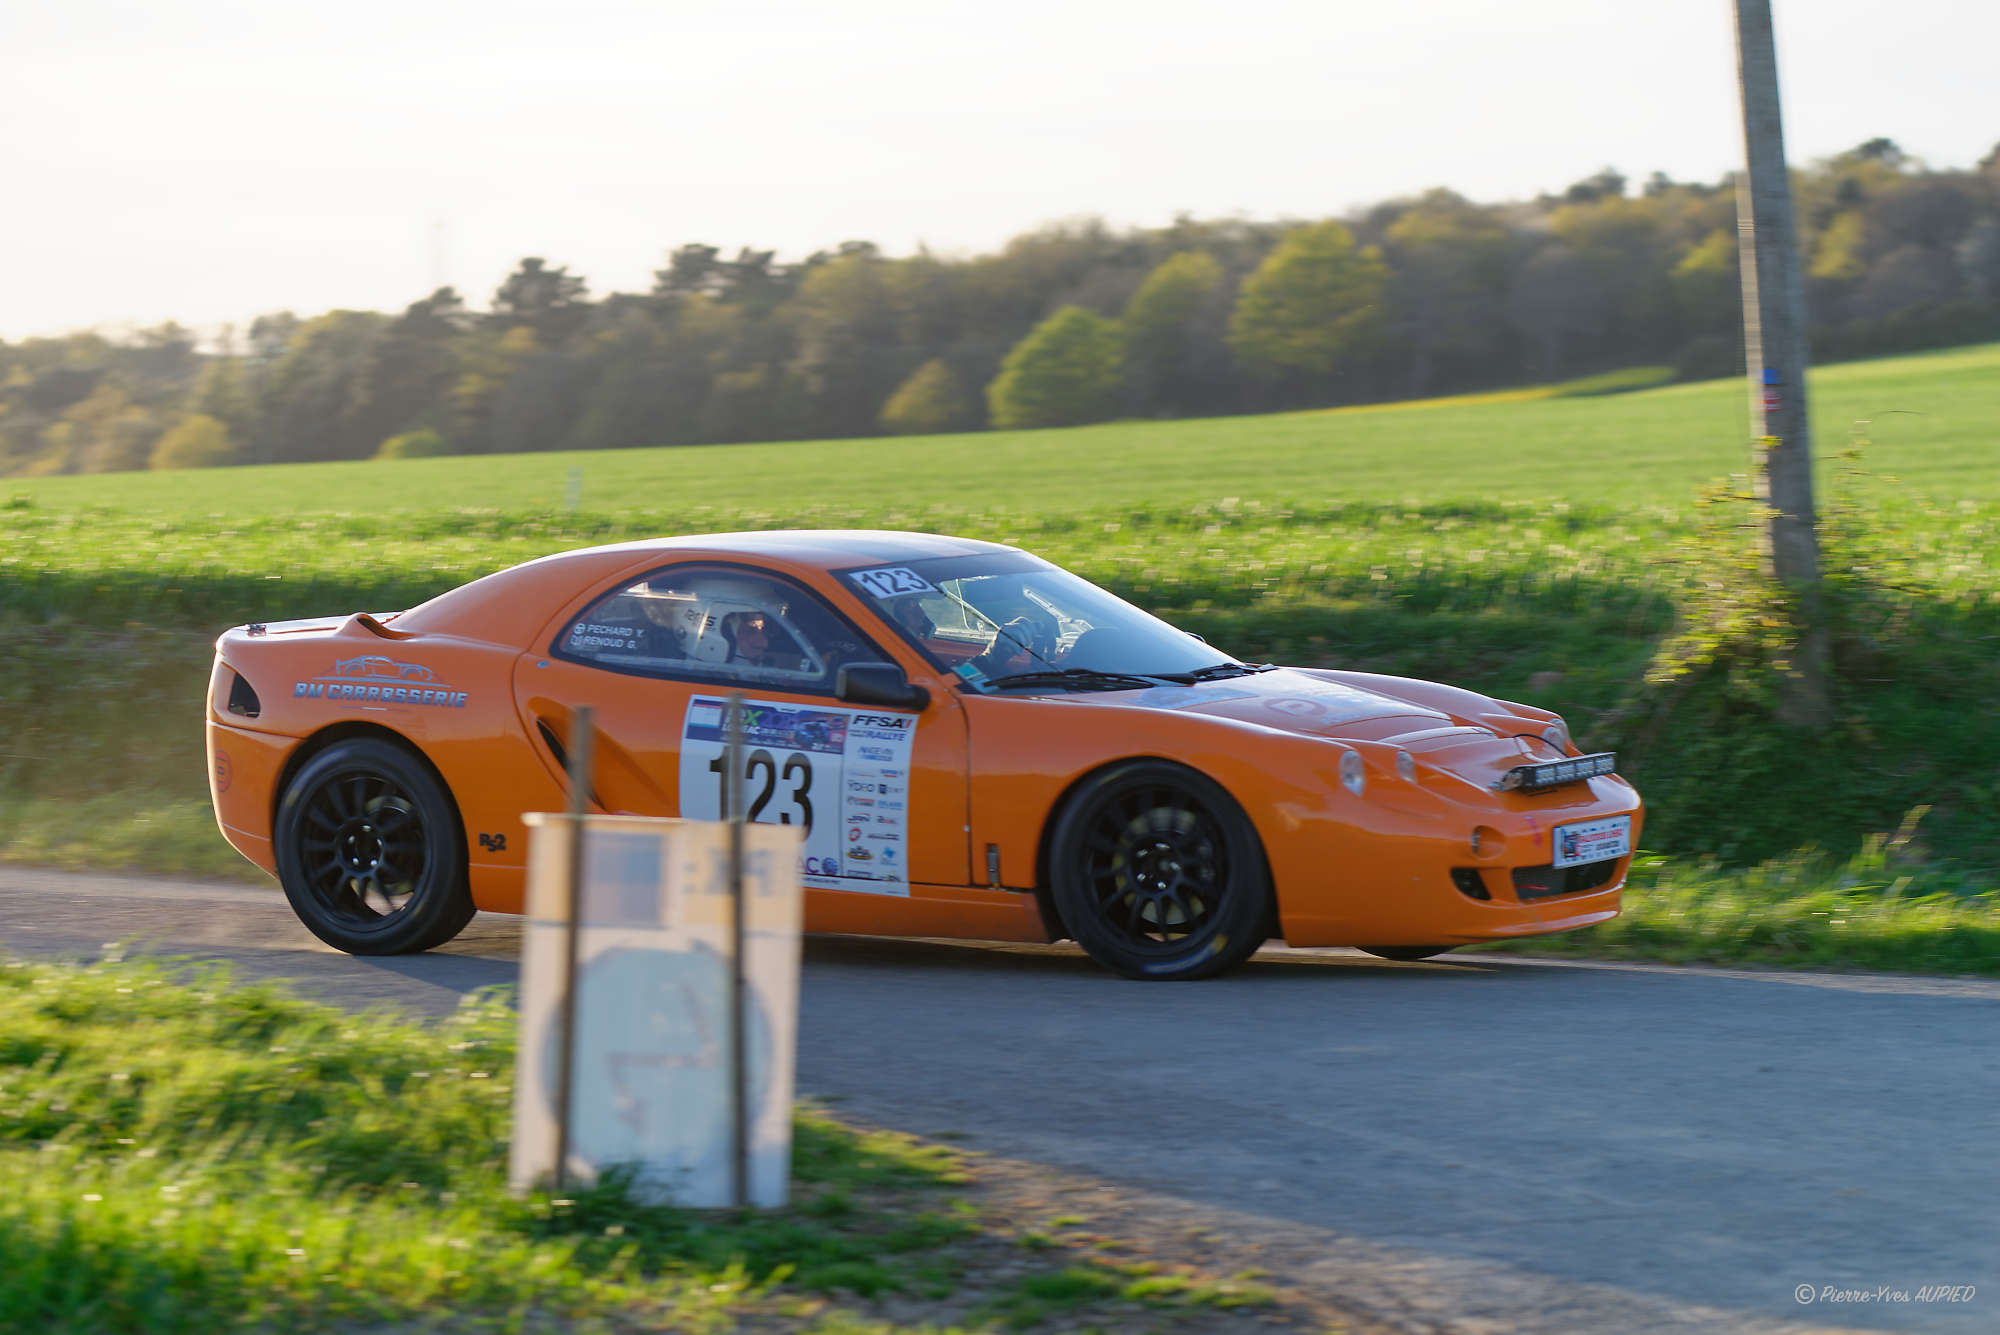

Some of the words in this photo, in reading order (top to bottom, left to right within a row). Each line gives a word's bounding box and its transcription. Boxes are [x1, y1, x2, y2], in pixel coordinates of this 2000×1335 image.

[862, 569, 928, 594] 123
[293, 682, 325, 699] BM
[327, 684, 469, 708] CARROSSERIE
[852, 714, 904, 729] FFSA
[709, 746, 813, 842] 123
